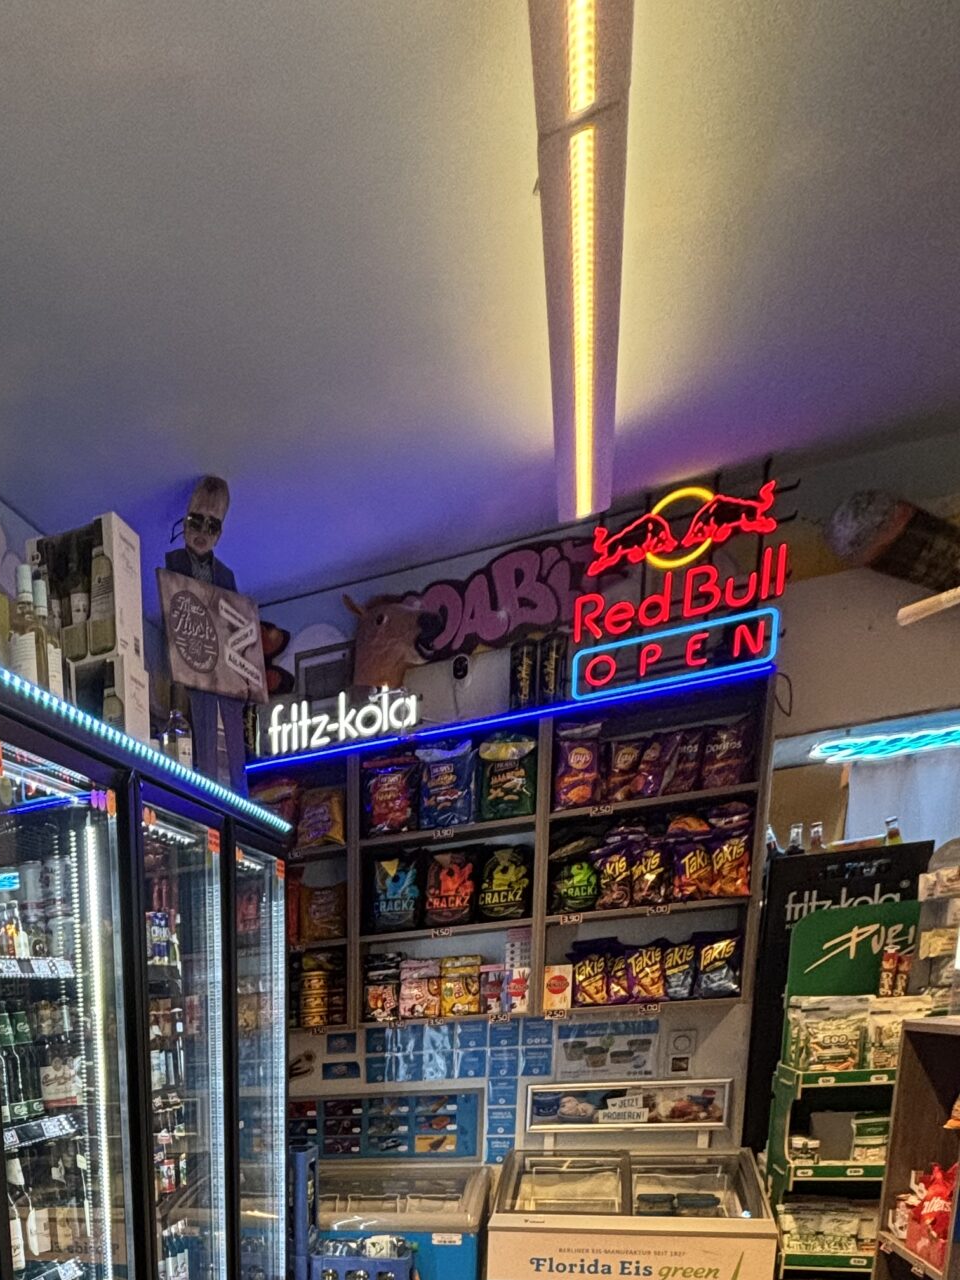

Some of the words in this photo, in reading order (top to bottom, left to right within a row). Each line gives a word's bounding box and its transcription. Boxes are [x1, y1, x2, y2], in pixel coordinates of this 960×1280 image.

[573, 571, 672, 643] Red
[683, 543, 787, 618] Bull
[585, 620, 765, 687] OPEN
[268, 684, 417, 756] fritz-kola
[682, 850, 708, 878] Taki
[712, 842, 746, 874] Takis
[426, 897, 470, 910] CRACKZ
[478, 890, 523, 905] CRACKZ
[628, 946, 661, 977] Takis
[700, 940, 736, 971] Takis
[619, 1098, 638, 1108] JETZT
[530, 1257, 612, 1275] Florida
[619, 1260, 653, 1276] Eis
[658, 1264, 720, 1280] green
